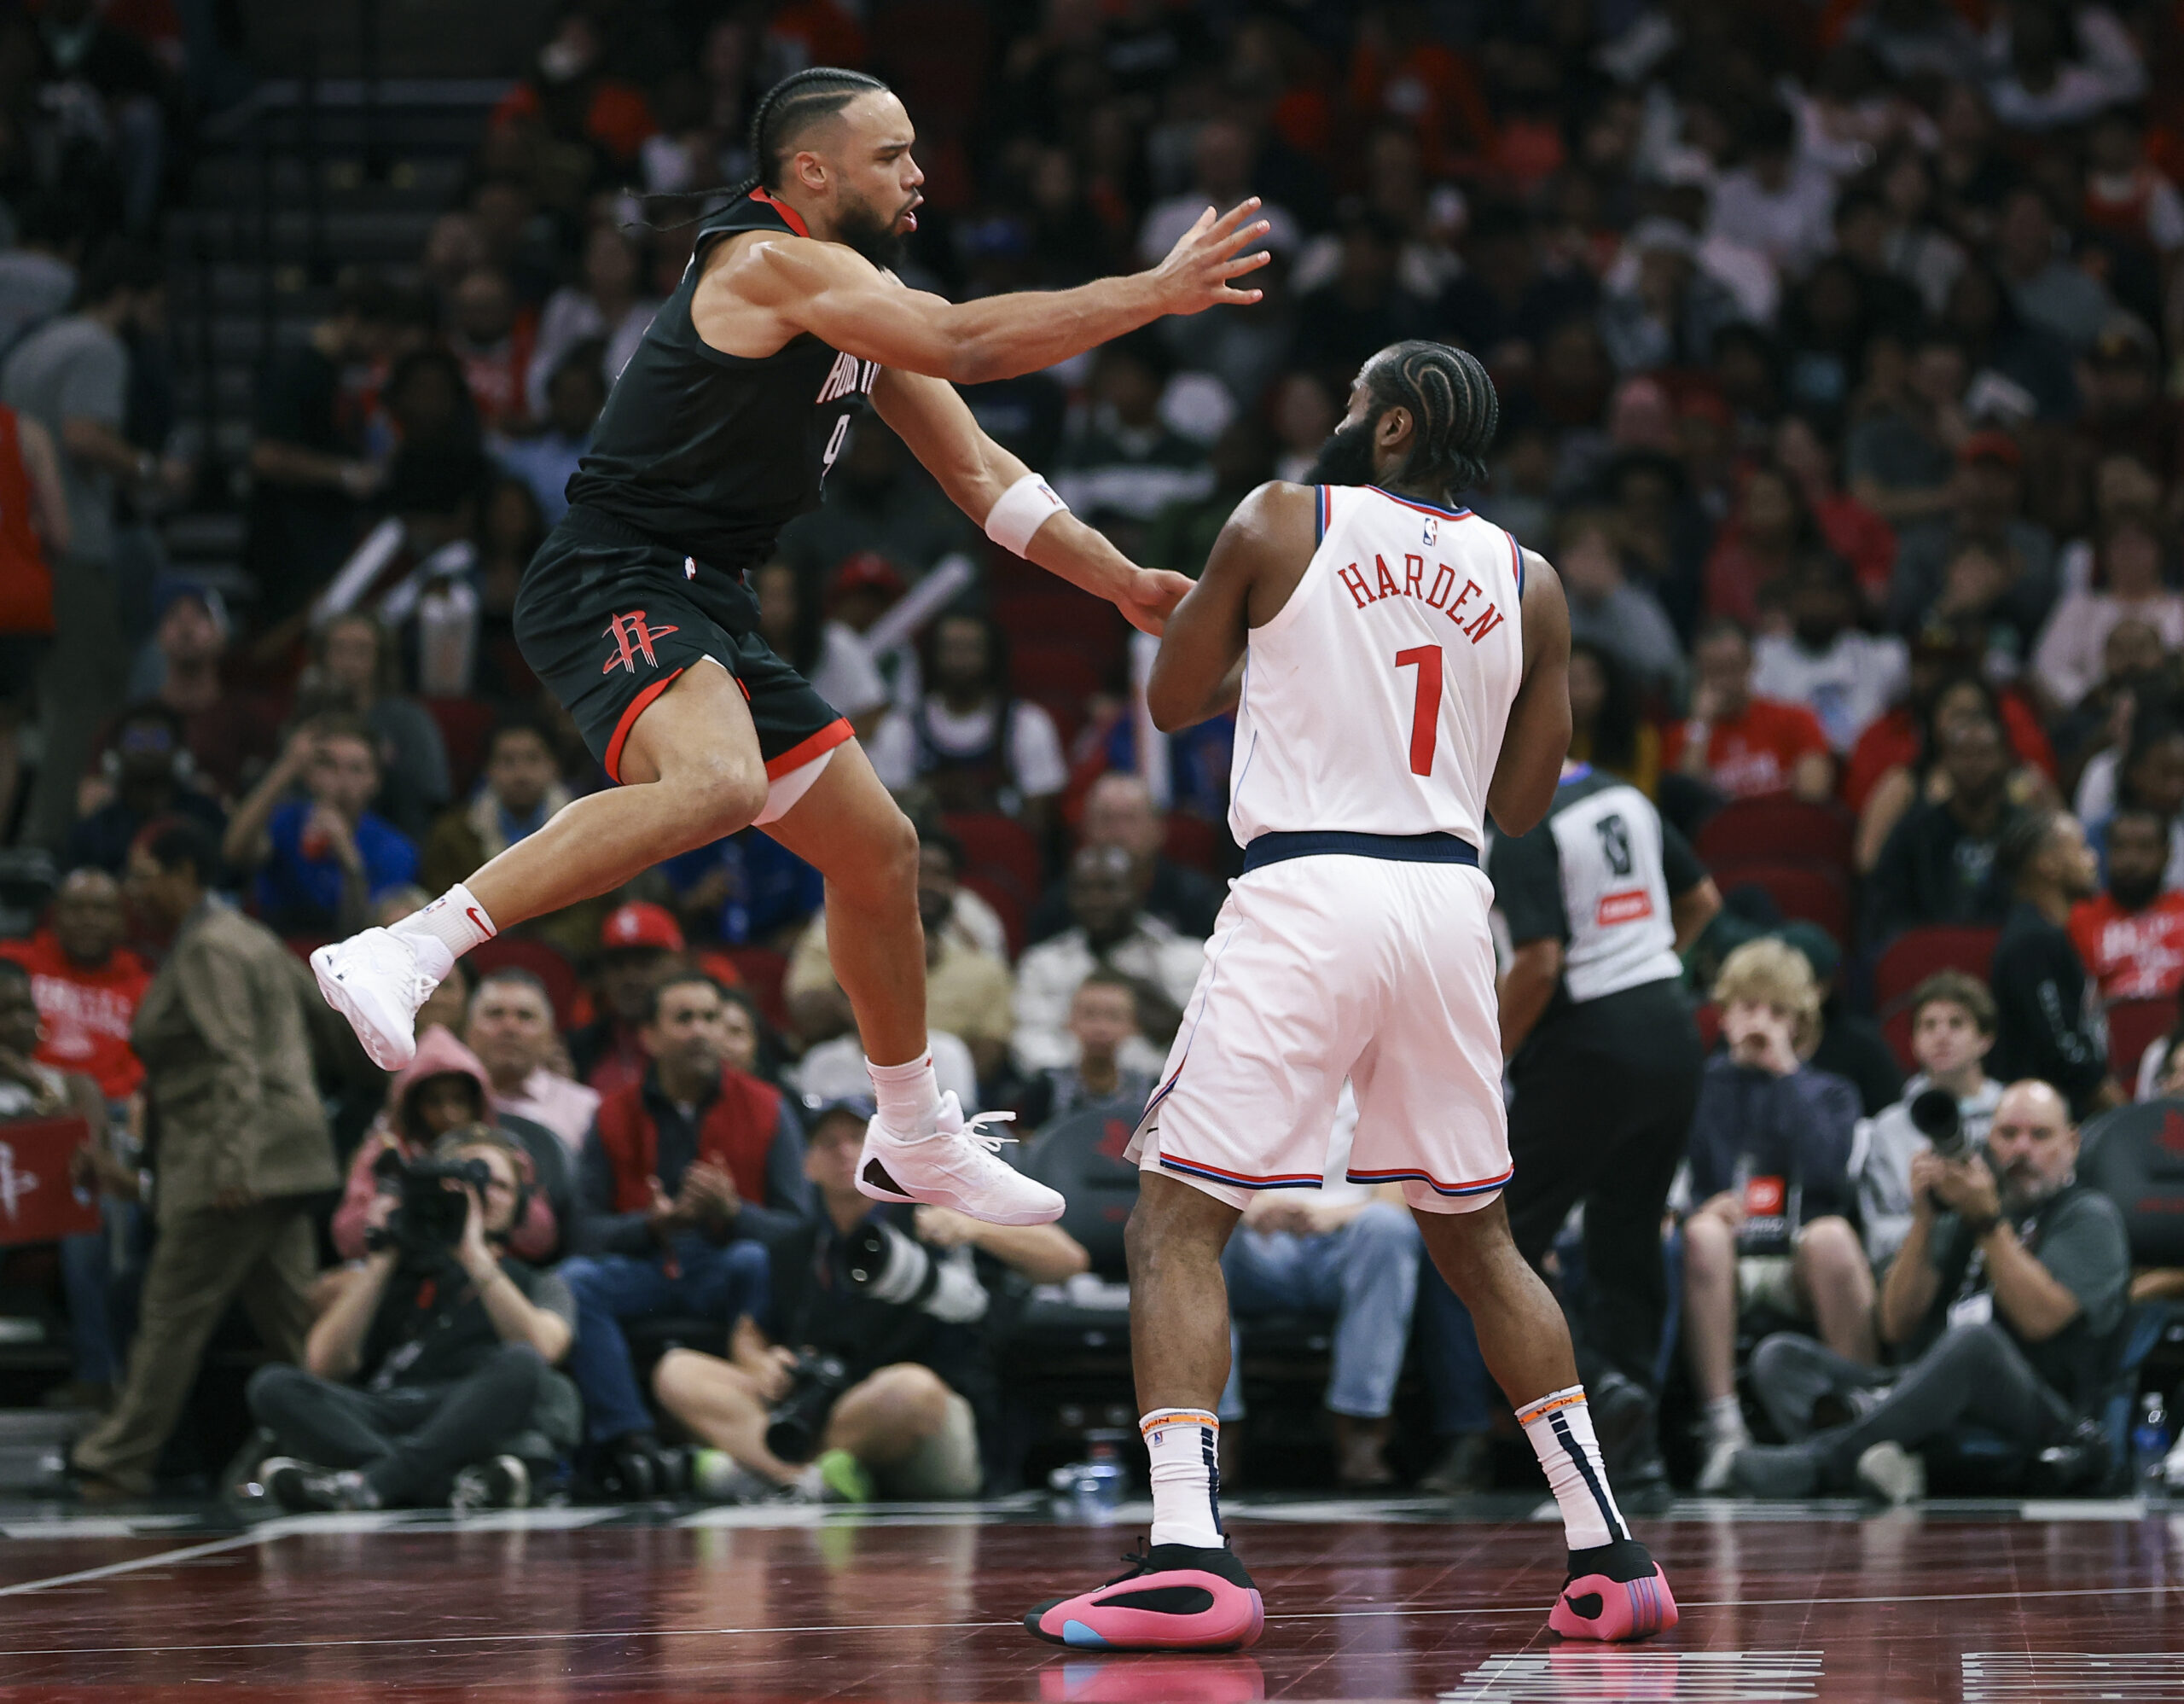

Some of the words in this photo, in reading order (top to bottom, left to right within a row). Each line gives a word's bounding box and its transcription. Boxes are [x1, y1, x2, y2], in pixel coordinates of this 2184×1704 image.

[820, 413, 851, 491] 9
[1337, 553, 1505, 645] HARDEN
[1395, 644, 1443, 777] 1
